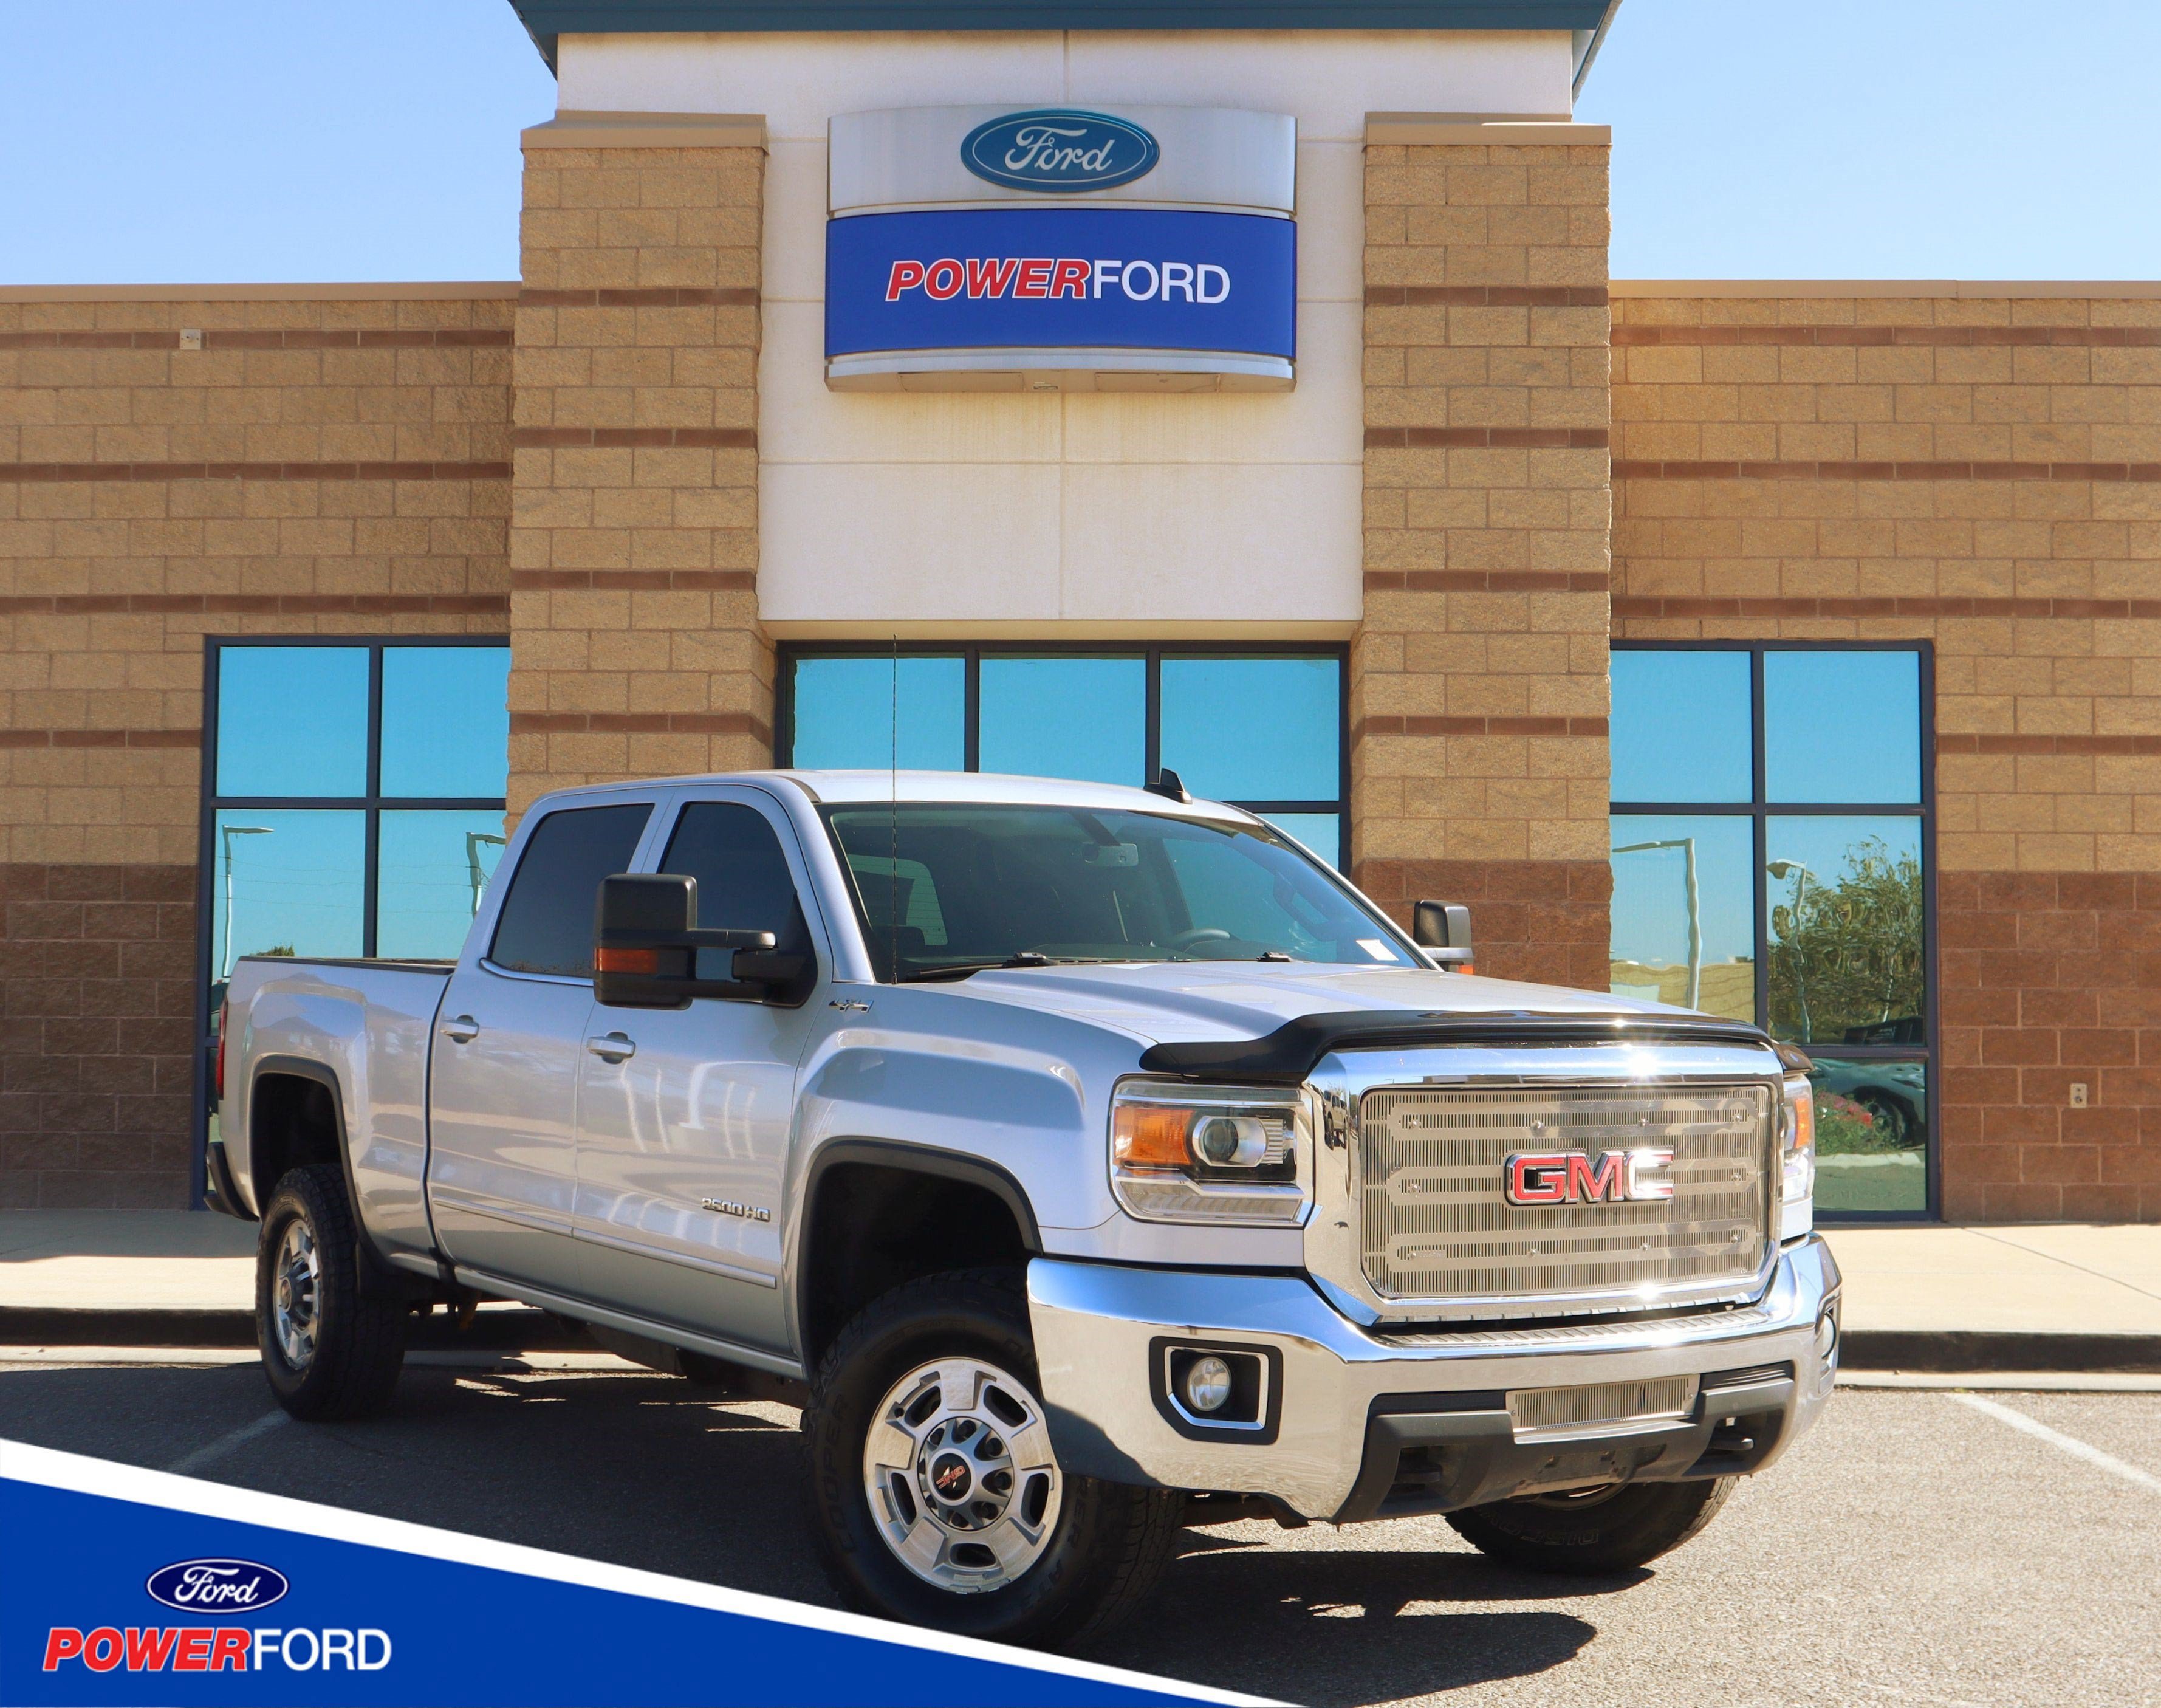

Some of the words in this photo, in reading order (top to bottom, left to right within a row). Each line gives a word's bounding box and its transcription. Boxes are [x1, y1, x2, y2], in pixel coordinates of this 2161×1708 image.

[1004, 125, 1115, 173] Ford
[1504, 1150, 1673, 1205] GMC
[936, 1465, 965, 1489] GMC
